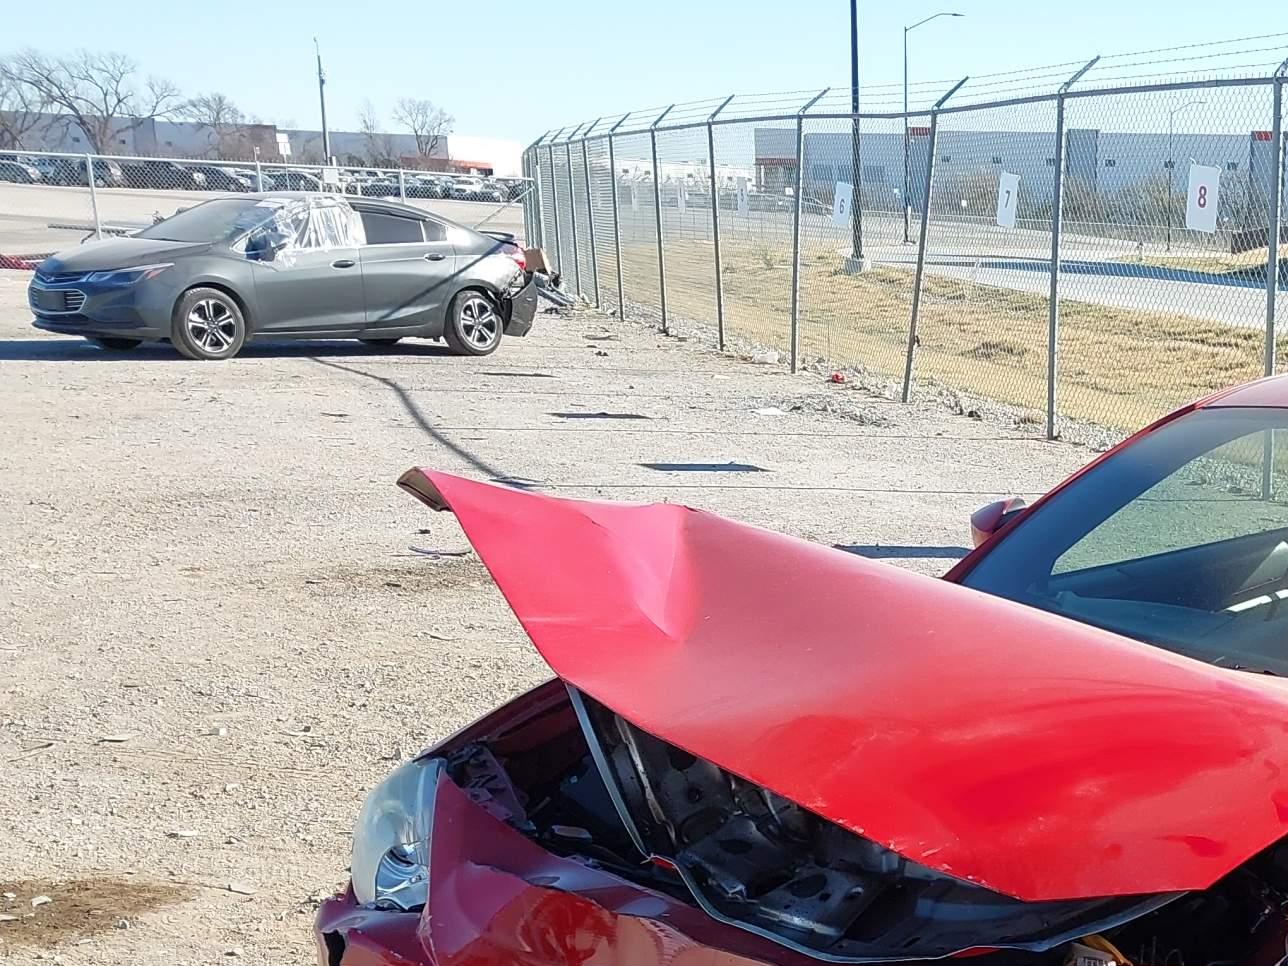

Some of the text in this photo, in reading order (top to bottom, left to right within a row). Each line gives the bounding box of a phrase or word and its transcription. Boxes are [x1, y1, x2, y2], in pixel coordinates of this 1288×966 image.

[1003, 190, 1011, 208] 7
[1198, 185, 1208, 208] 8
[839, 198, 846, 214] 6
